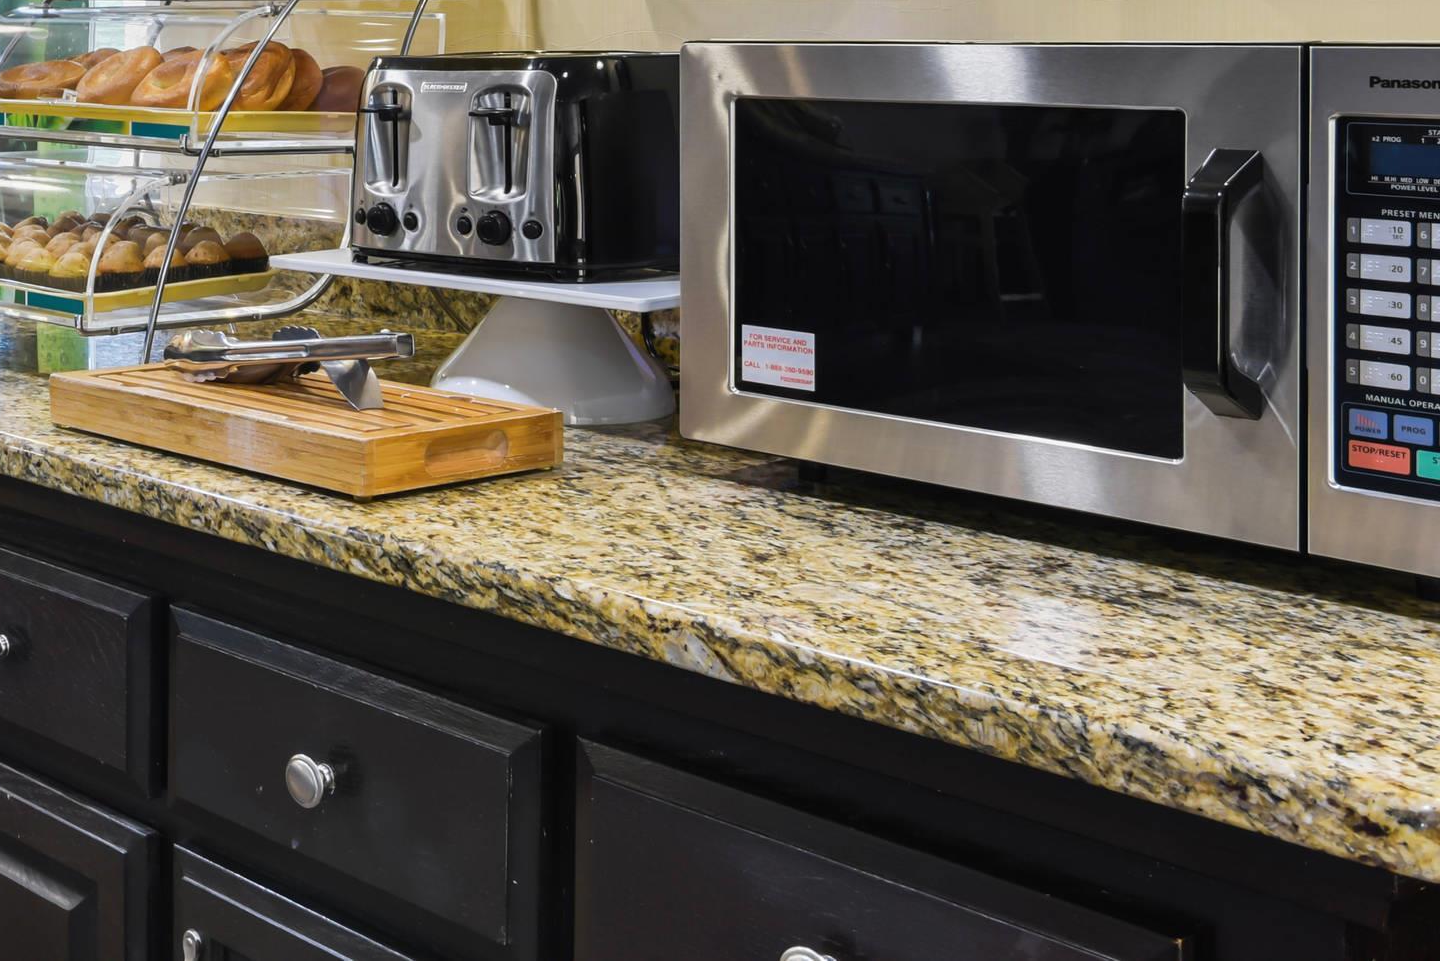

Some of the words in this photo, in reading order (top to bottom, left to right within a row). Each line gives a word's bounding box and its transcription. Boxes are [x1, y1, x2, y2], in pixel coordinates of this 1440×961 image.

[1369, 76, 1440, 90] Panason
[1417, 185, 1439, 193] LEVEL
[1381, 209, 1416, 218] PRESET
[1420, 231, 1427, 239] 6
[1350, 261, 1357, 270] 2
[1420, 267, 1427, 276] 7
[1350, 297, 1356, 305] 3
[1420, 303, 1427, 312] 8
[765, 335, 790, 344] SERVICE
[1349, 332, 1355, 340] 4
[744, 340, 764, 348] PARTS
[767, 344, 813, 354] INFORMATION
[1420, 340, 1427, 348] 9
[1349, 367, 1356, 375] 5
[1420, 376, 1427, 384] 0
[1365, 394, 1407, 406] MANUAL
[1355, 426, 1381, 434] POWER
[1401, 426, 1426, 435] PROG
[1352, 444, 1407, 459] STOP/RESET
